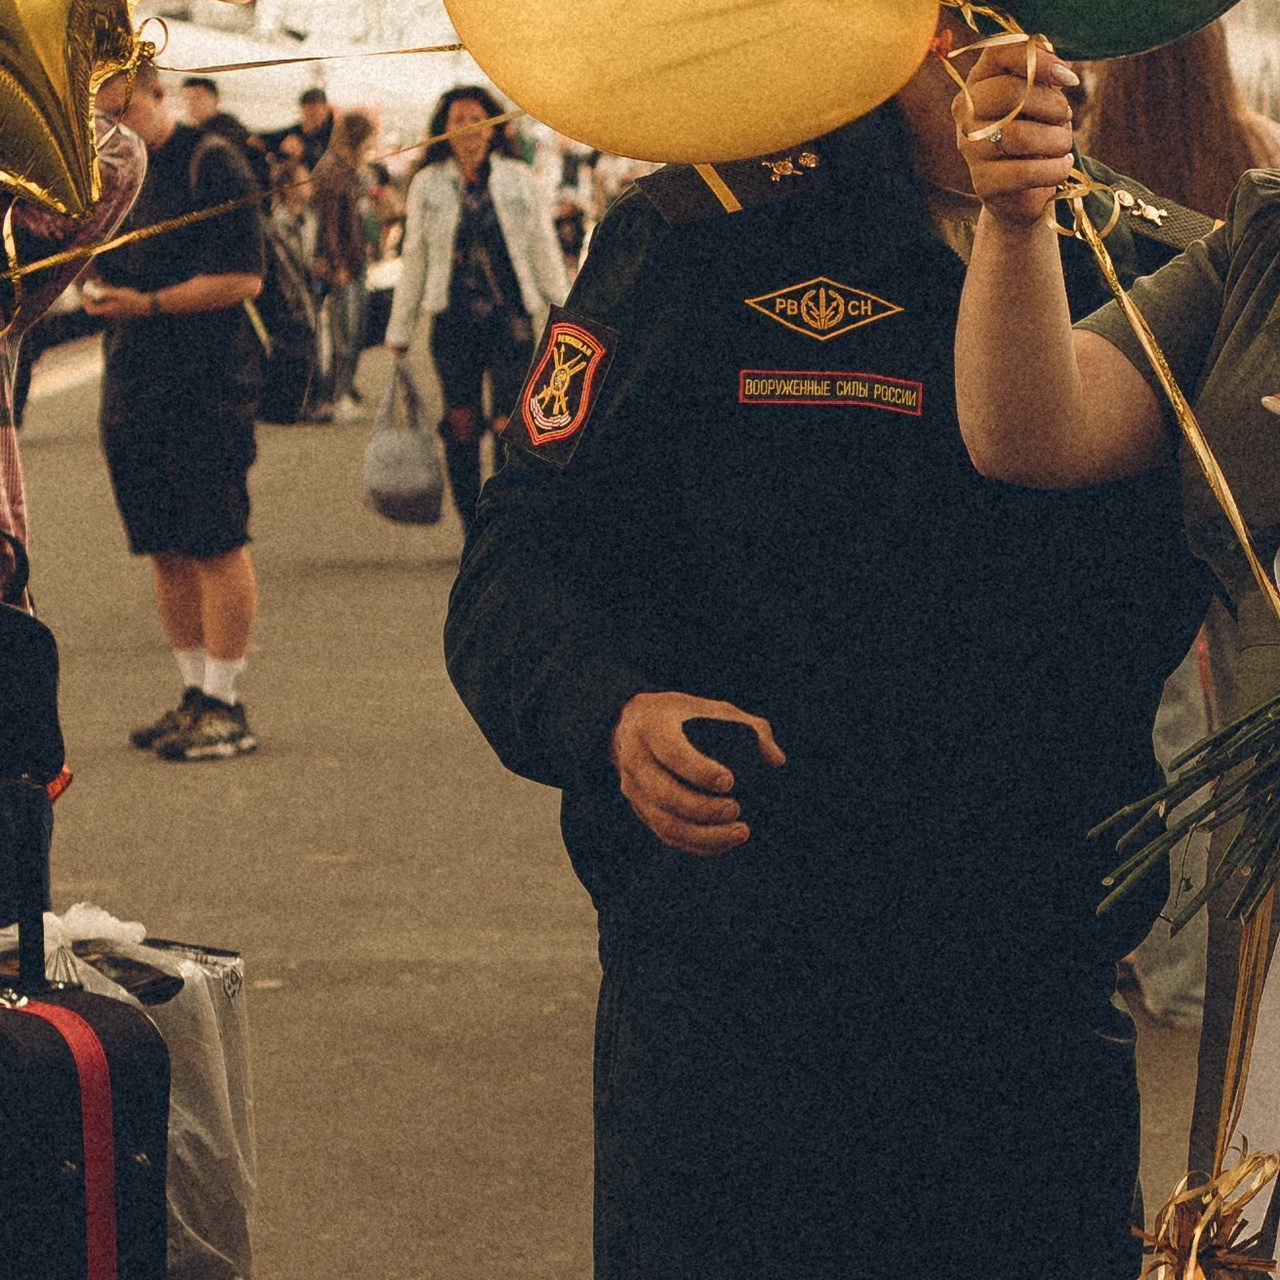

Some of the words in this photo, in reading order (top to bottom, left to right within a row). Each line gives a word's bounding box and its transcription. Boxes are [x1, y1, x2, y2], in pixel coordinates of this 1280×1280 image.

[775, 298, 798, 315] РВ
[848, 299, 872, 316] СН
[745, 379, 831, 396] ВООРУЖЕННЫЕ
[836, 380, 869, 398] СИЛЫ
[874, 384, 917, 406] РОССИИ
